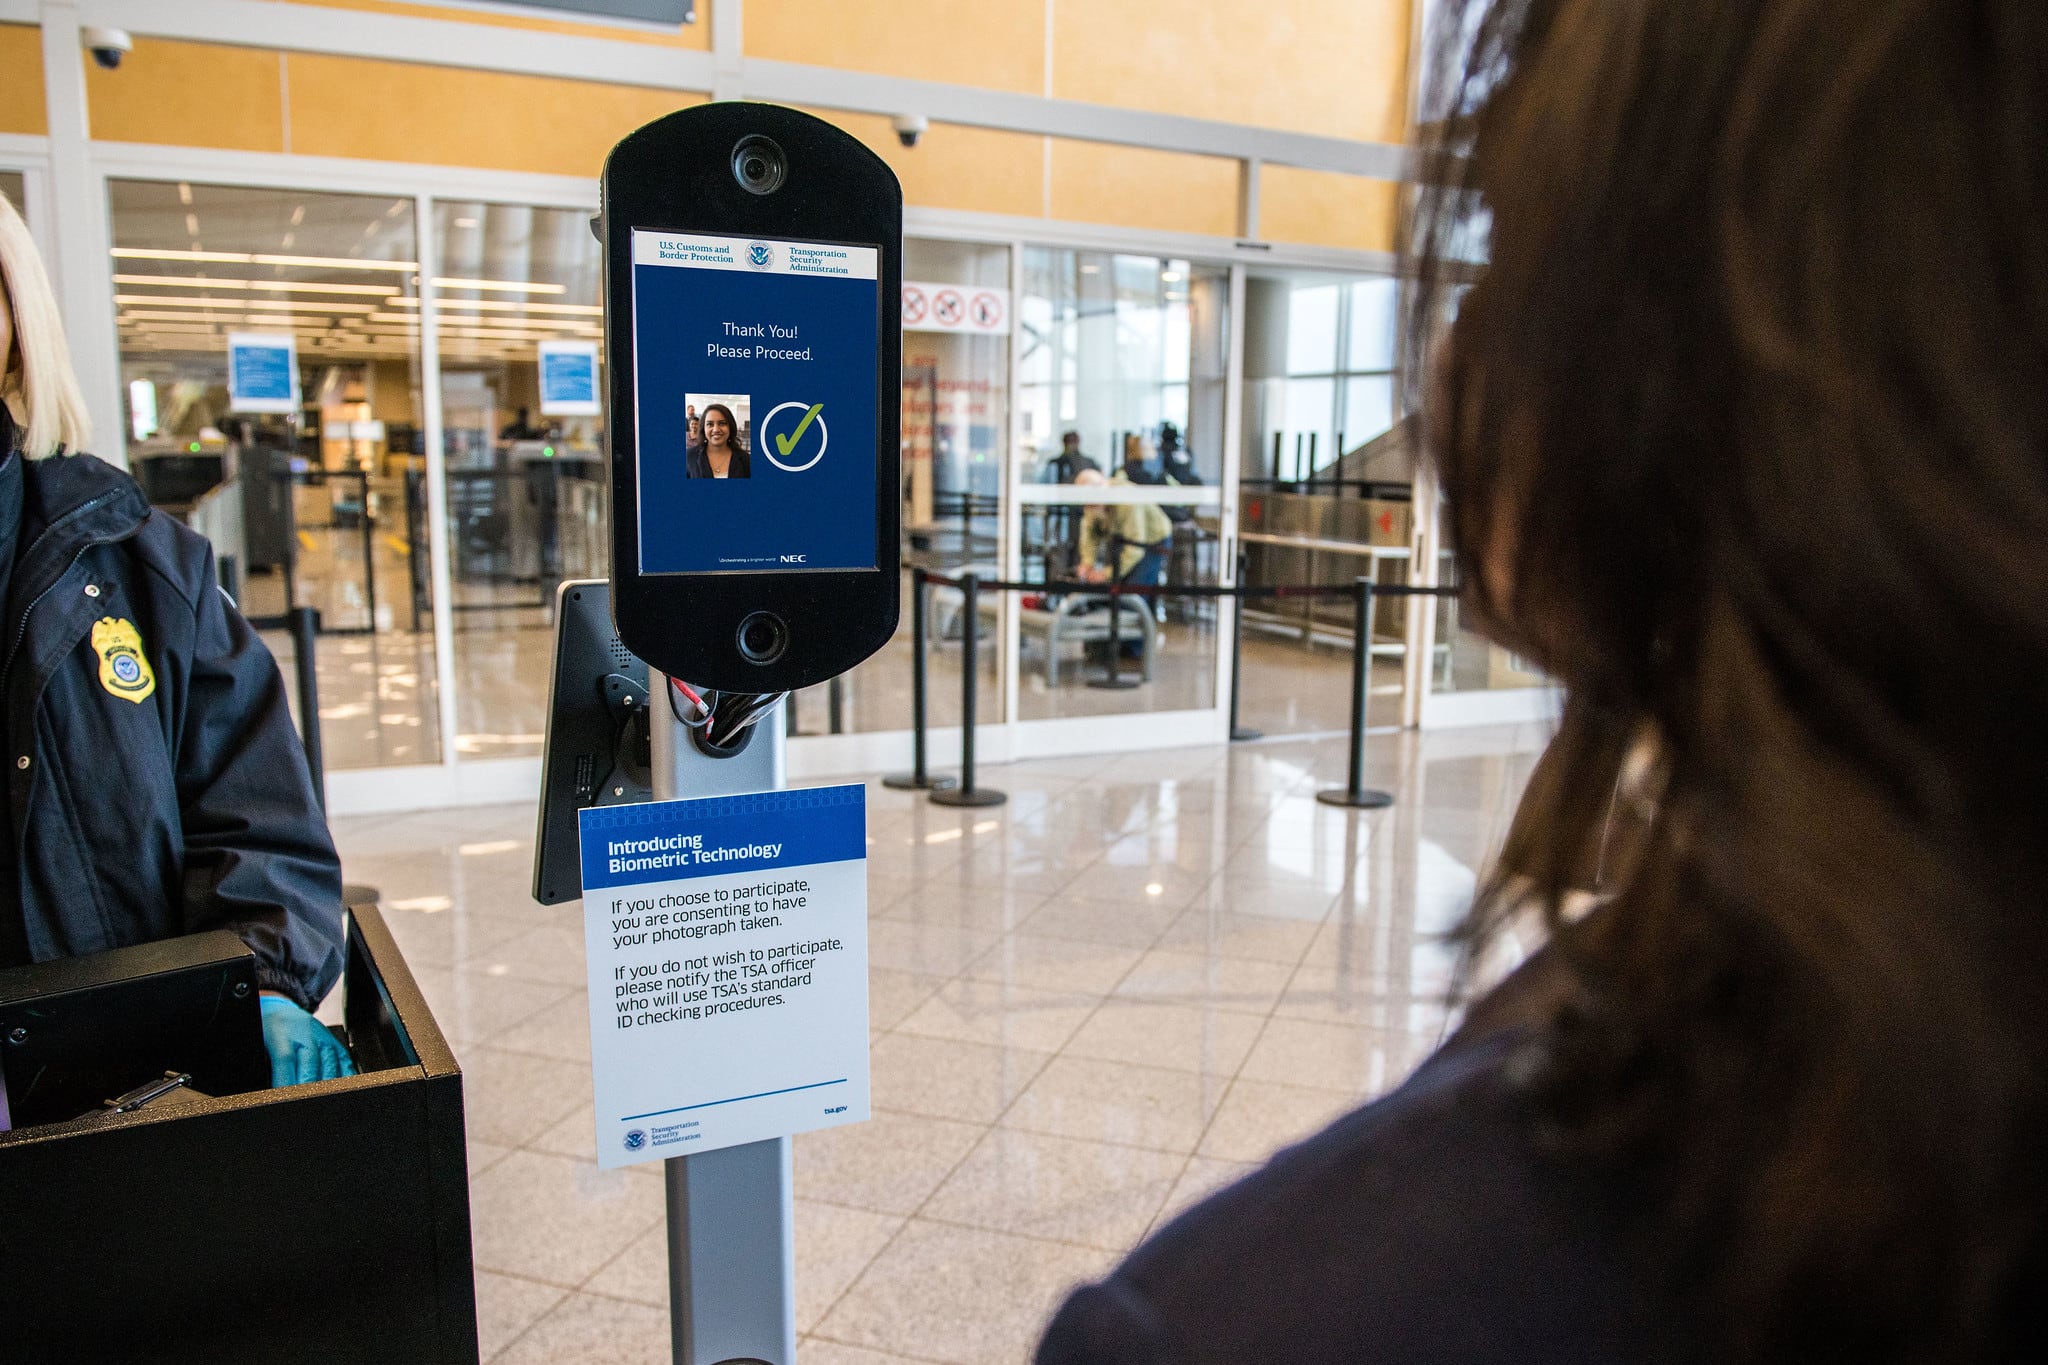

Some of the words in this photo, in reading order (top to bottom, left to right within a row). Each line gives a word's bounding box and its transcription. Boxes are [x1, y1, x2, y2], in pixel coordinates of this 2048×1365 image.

[659, 241, 676, 250] U.S.
[676, 242, 713, 253] Customs
[714, 245, 730, 254] and
[789, 247, 847, 258] Transportation
[659, 251, 688, 260] Border
[691, 252, 734, 263] Protection
[789, 255, 823, 266] Security
[789, 263, 849, 274] Administration
[722, 321, 765, 338] Thank
[768, 323, 798, 339] You!
[707, 343, 751, 359] Please
[755, 345, 814, 361] Proceed.
[780, 554, 807, 563] NEC
[608, 833, 703, 856] Introducing
[608, 852, 689, 874] Biometric
[692, 842, 783, 864] Technology
[611, 900, 623, 914] If
[626, 898, 655, 915] you
[658, 890, 711, 910] choose
[714, 888, 729, 902] to
[732, 879, 811, 902] participate,
[612, 915, 641, 933] you
[644, 912, 669, 927] are
[672, 901, 751, 924] consenting
[754, 899, 769, 913] to
[772, 895, 807, 912] have
[612, 931, 648, 950] your
[652, 919, 737, 945] photograph
[740, 915, 783, 932] taken.
[614, 966, 626, 980] If
[629, 963, 658, 981] you
[661, 959, 681, 974] do
[684, 955, 709, 971] not
[712, 949, 746, 967] wish
[749, 947, 764, 961] to
[767, 938, 844, 960] participate,
[615, 980, 663, 998] please
[667, 970, 711, 990] notify
[714, 967, 737, 982] the
[741, 963, 768, 979] TSA
[771, 956, 816, 975] officer
[616, 996, 649, 1013] who
[652, 990, 679, 1008] will
[683, 988, 708, 1003] use
[751, 971, 812, 992] standard
[617, 1015, 633, 1029] ID
[637, 1005, 701, 1026] checking
[704, 993, 786, 1018] procedures.
[824, 1104, 848, 1116] tsa.gov
[651, 1120, 700, 1134] Transportation
[651, 1131, 679, 1140] Security
[651, 1133, 702, 1147] Administration
